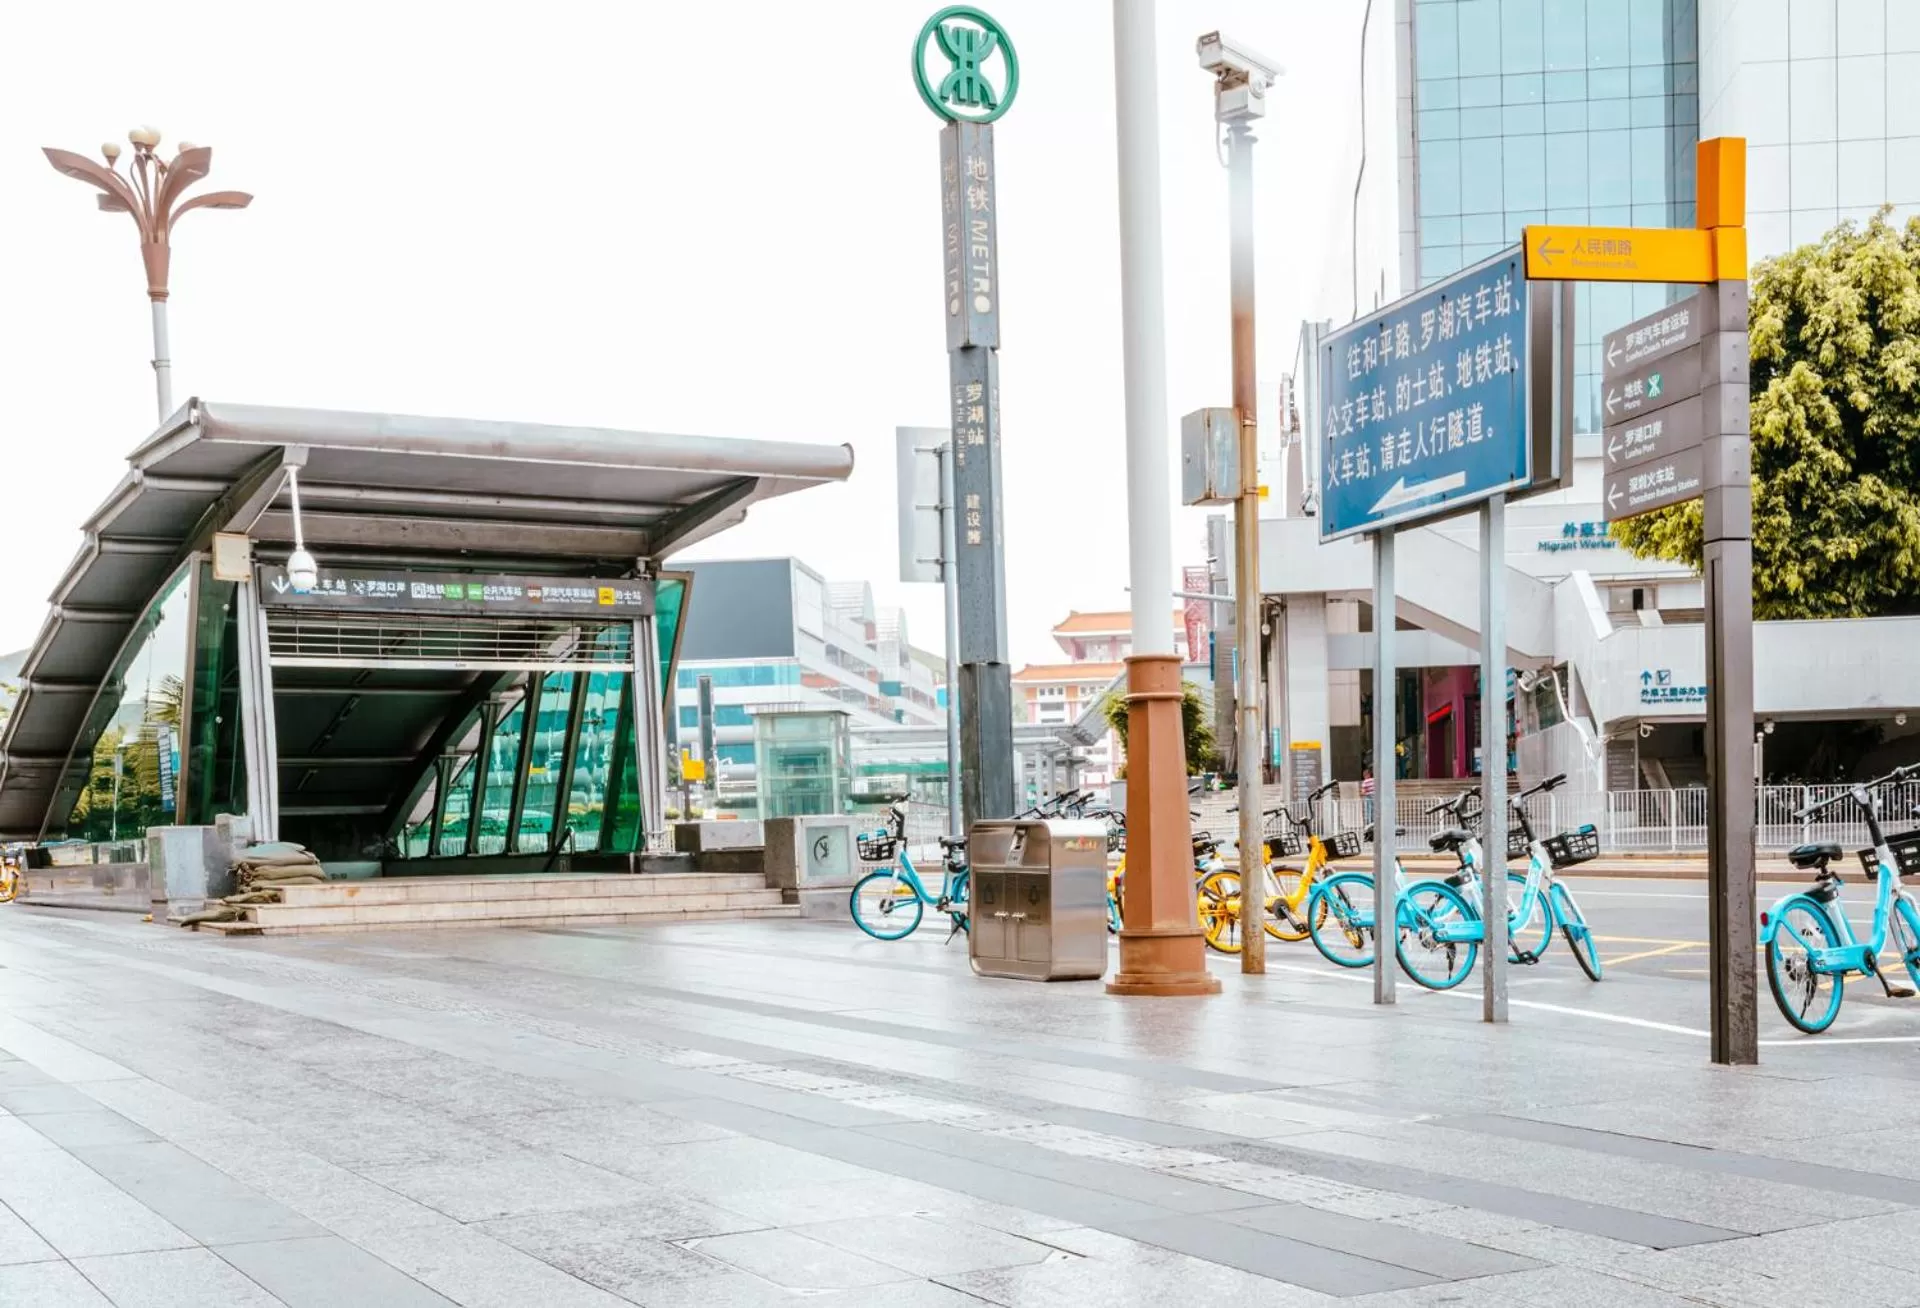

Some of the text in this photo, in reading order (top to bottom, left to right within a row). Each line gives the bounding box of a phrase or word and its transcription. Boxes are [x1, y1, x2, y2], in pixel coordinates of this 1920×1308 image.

[964, 155, 989, 213] 地铁
[1572, 238, 1632, 256] 人民南路
[970, 220, 991, 313] METRO
[1624, 378, 1643, 399] 地铁
[965, 382, 984, 446] 罗湖站
[1625, 420, 1662, 448] 罗湖口岸
[1629, 464, 1675, 493] 深圳火车站
[1537, 541, 1577, 554] Migrant
[312, 579, 346, 590] 车站
[367, 580, 405, 592] 罗湖口岸
